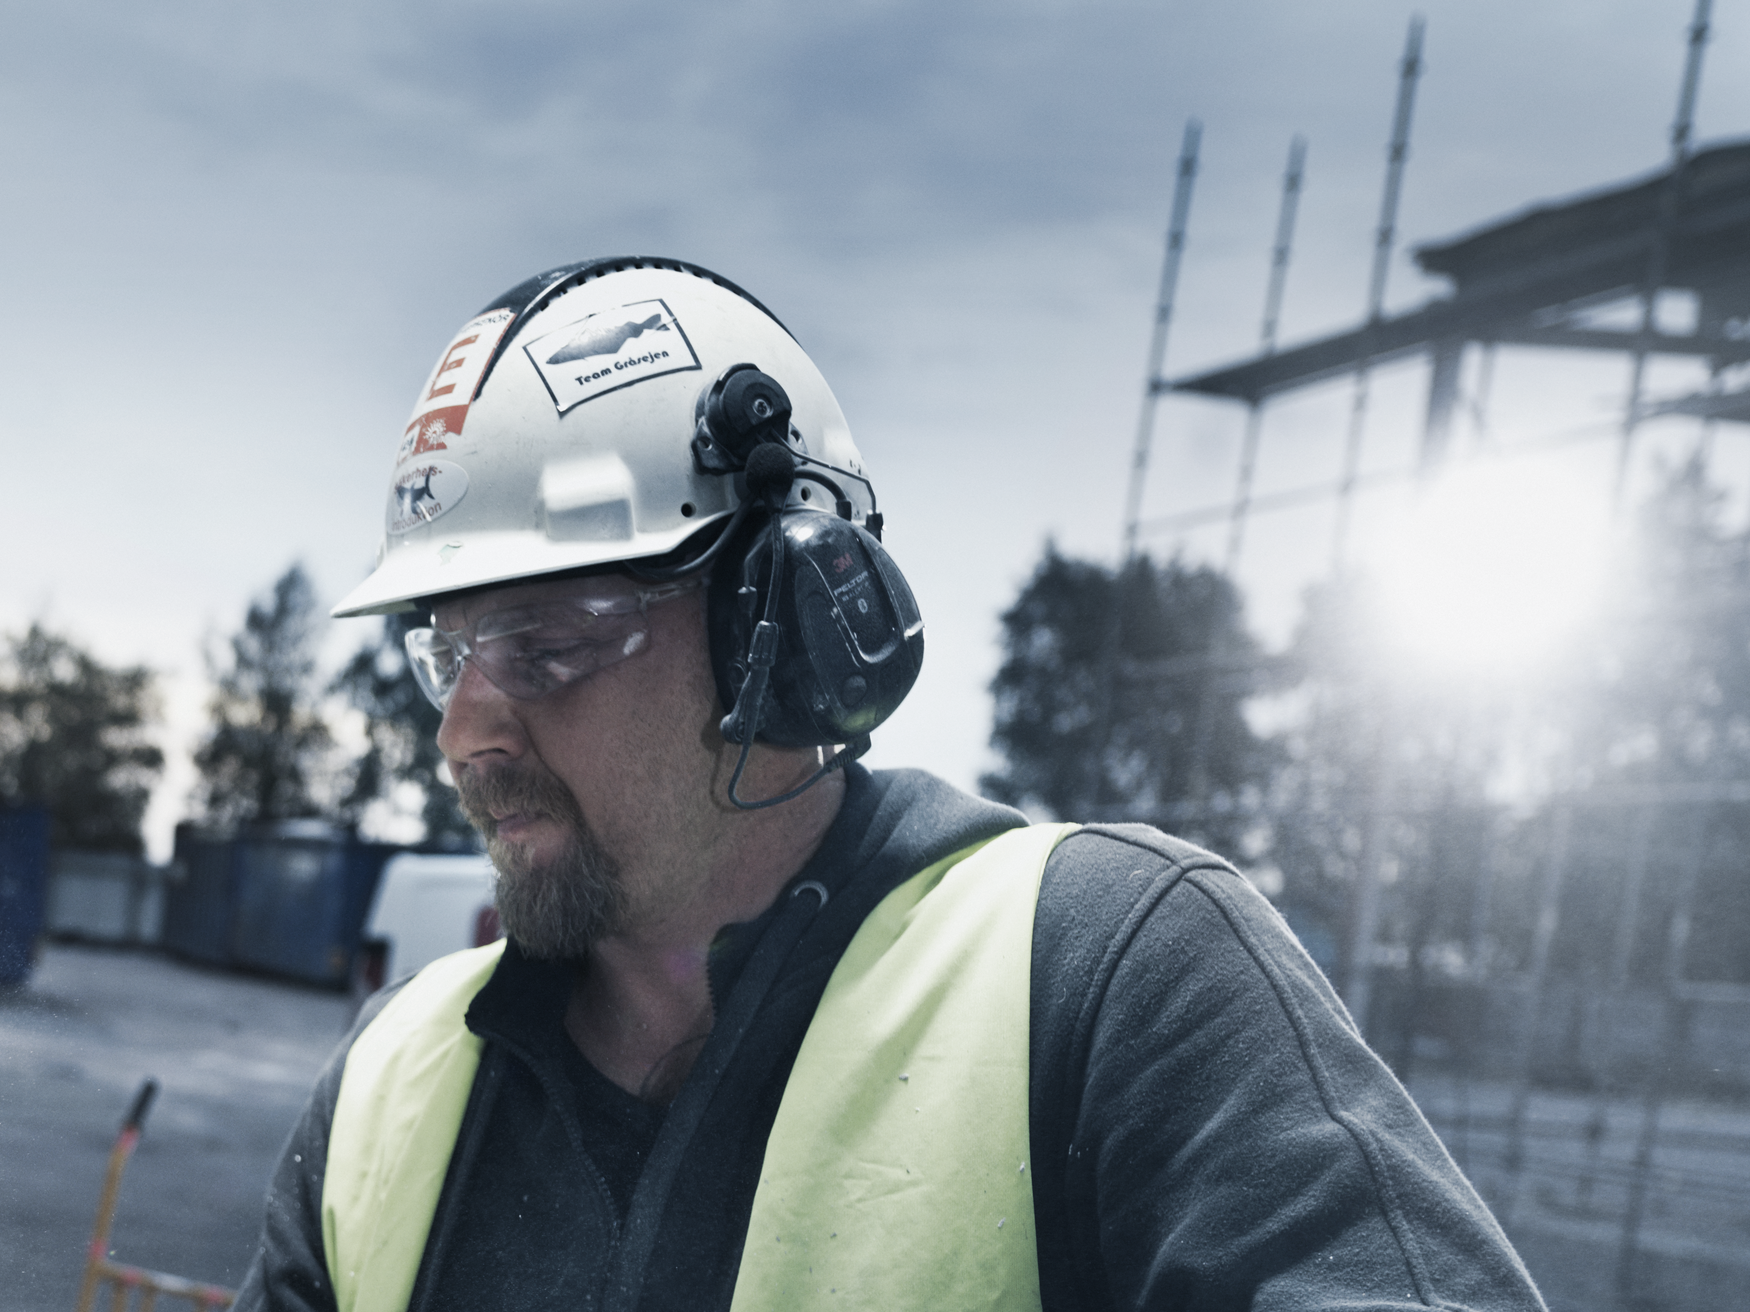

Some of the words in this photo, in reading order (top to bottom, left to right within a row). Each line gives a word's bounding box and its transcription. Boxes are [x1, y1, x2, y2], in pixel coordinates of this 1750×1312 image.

[574, 366, 612, 386] Team
[832, 552, 854, 573] 3M
[833, 570, 869, 597] PELTOR
